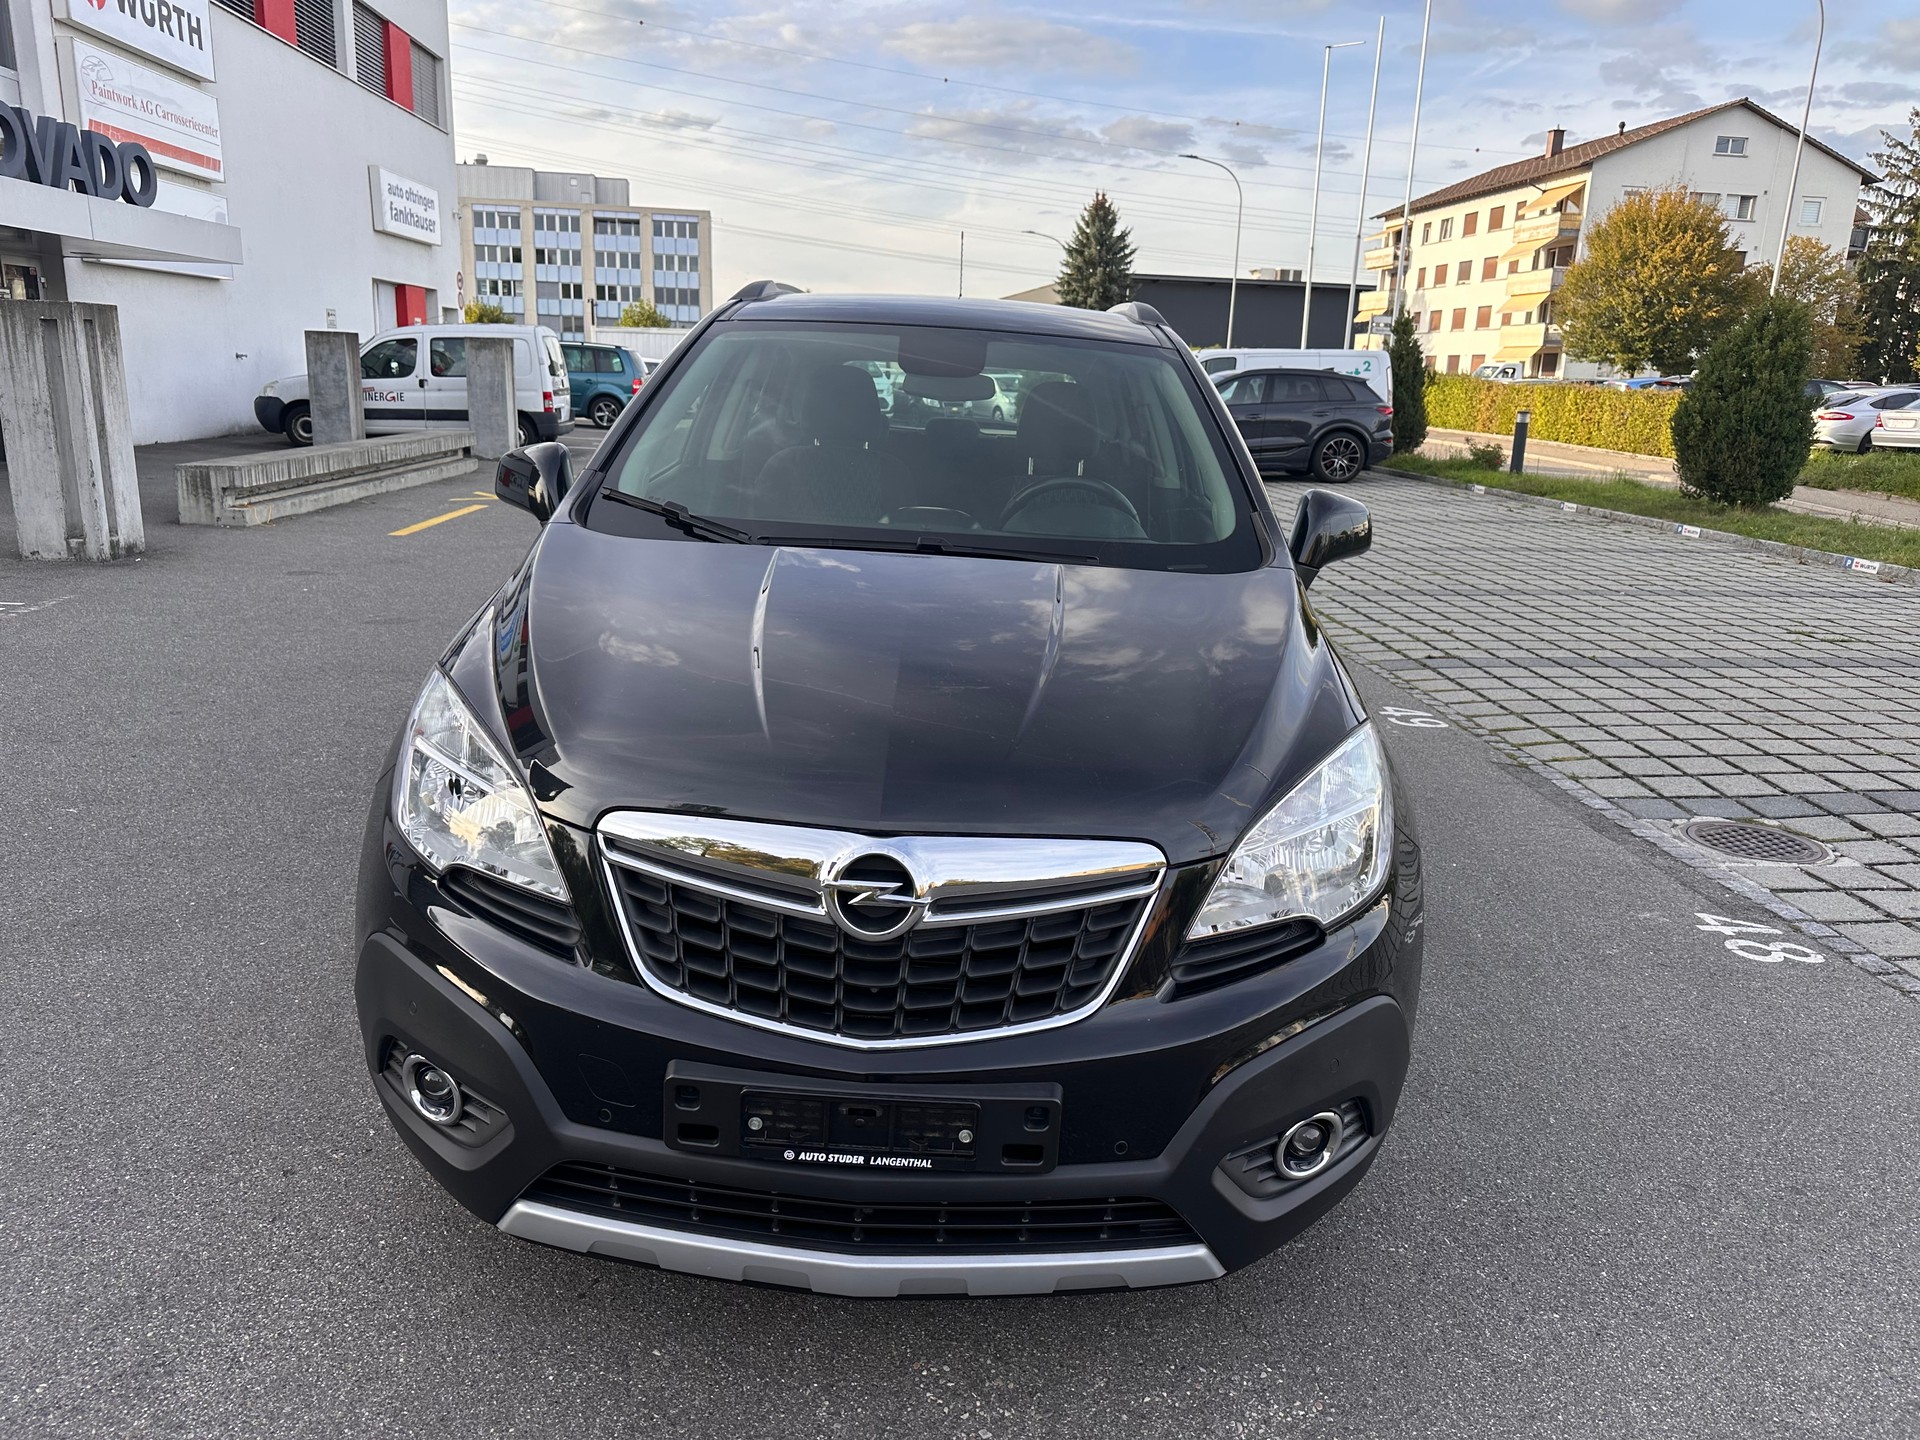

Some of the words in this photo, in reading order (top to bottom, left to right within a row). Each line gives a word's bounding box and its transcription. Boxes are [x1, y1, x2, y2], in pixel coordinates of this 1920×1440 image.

[91, 80, 138, 109] Paintwork
[139, 100, 154, 116] AG
[155, 104, 219, 138] Carrosseriecenter
[0, 101, 158, 208] OVADO
[387, 183, 404, 199] auto
[405, 187, 435, 212] oftringen
[390, 201, 436, 233] fankhauser
[1363, 360, 1371, 372] 2
[1378, 706, 1449, 728] 49
[1694, 912, 1826, 963] 48
[798, 1151, 826, 1162] AUTO
[827, 1153, 864, 1164] STUDER
[870, 1156, 932, 1168] LANGENTHAL
